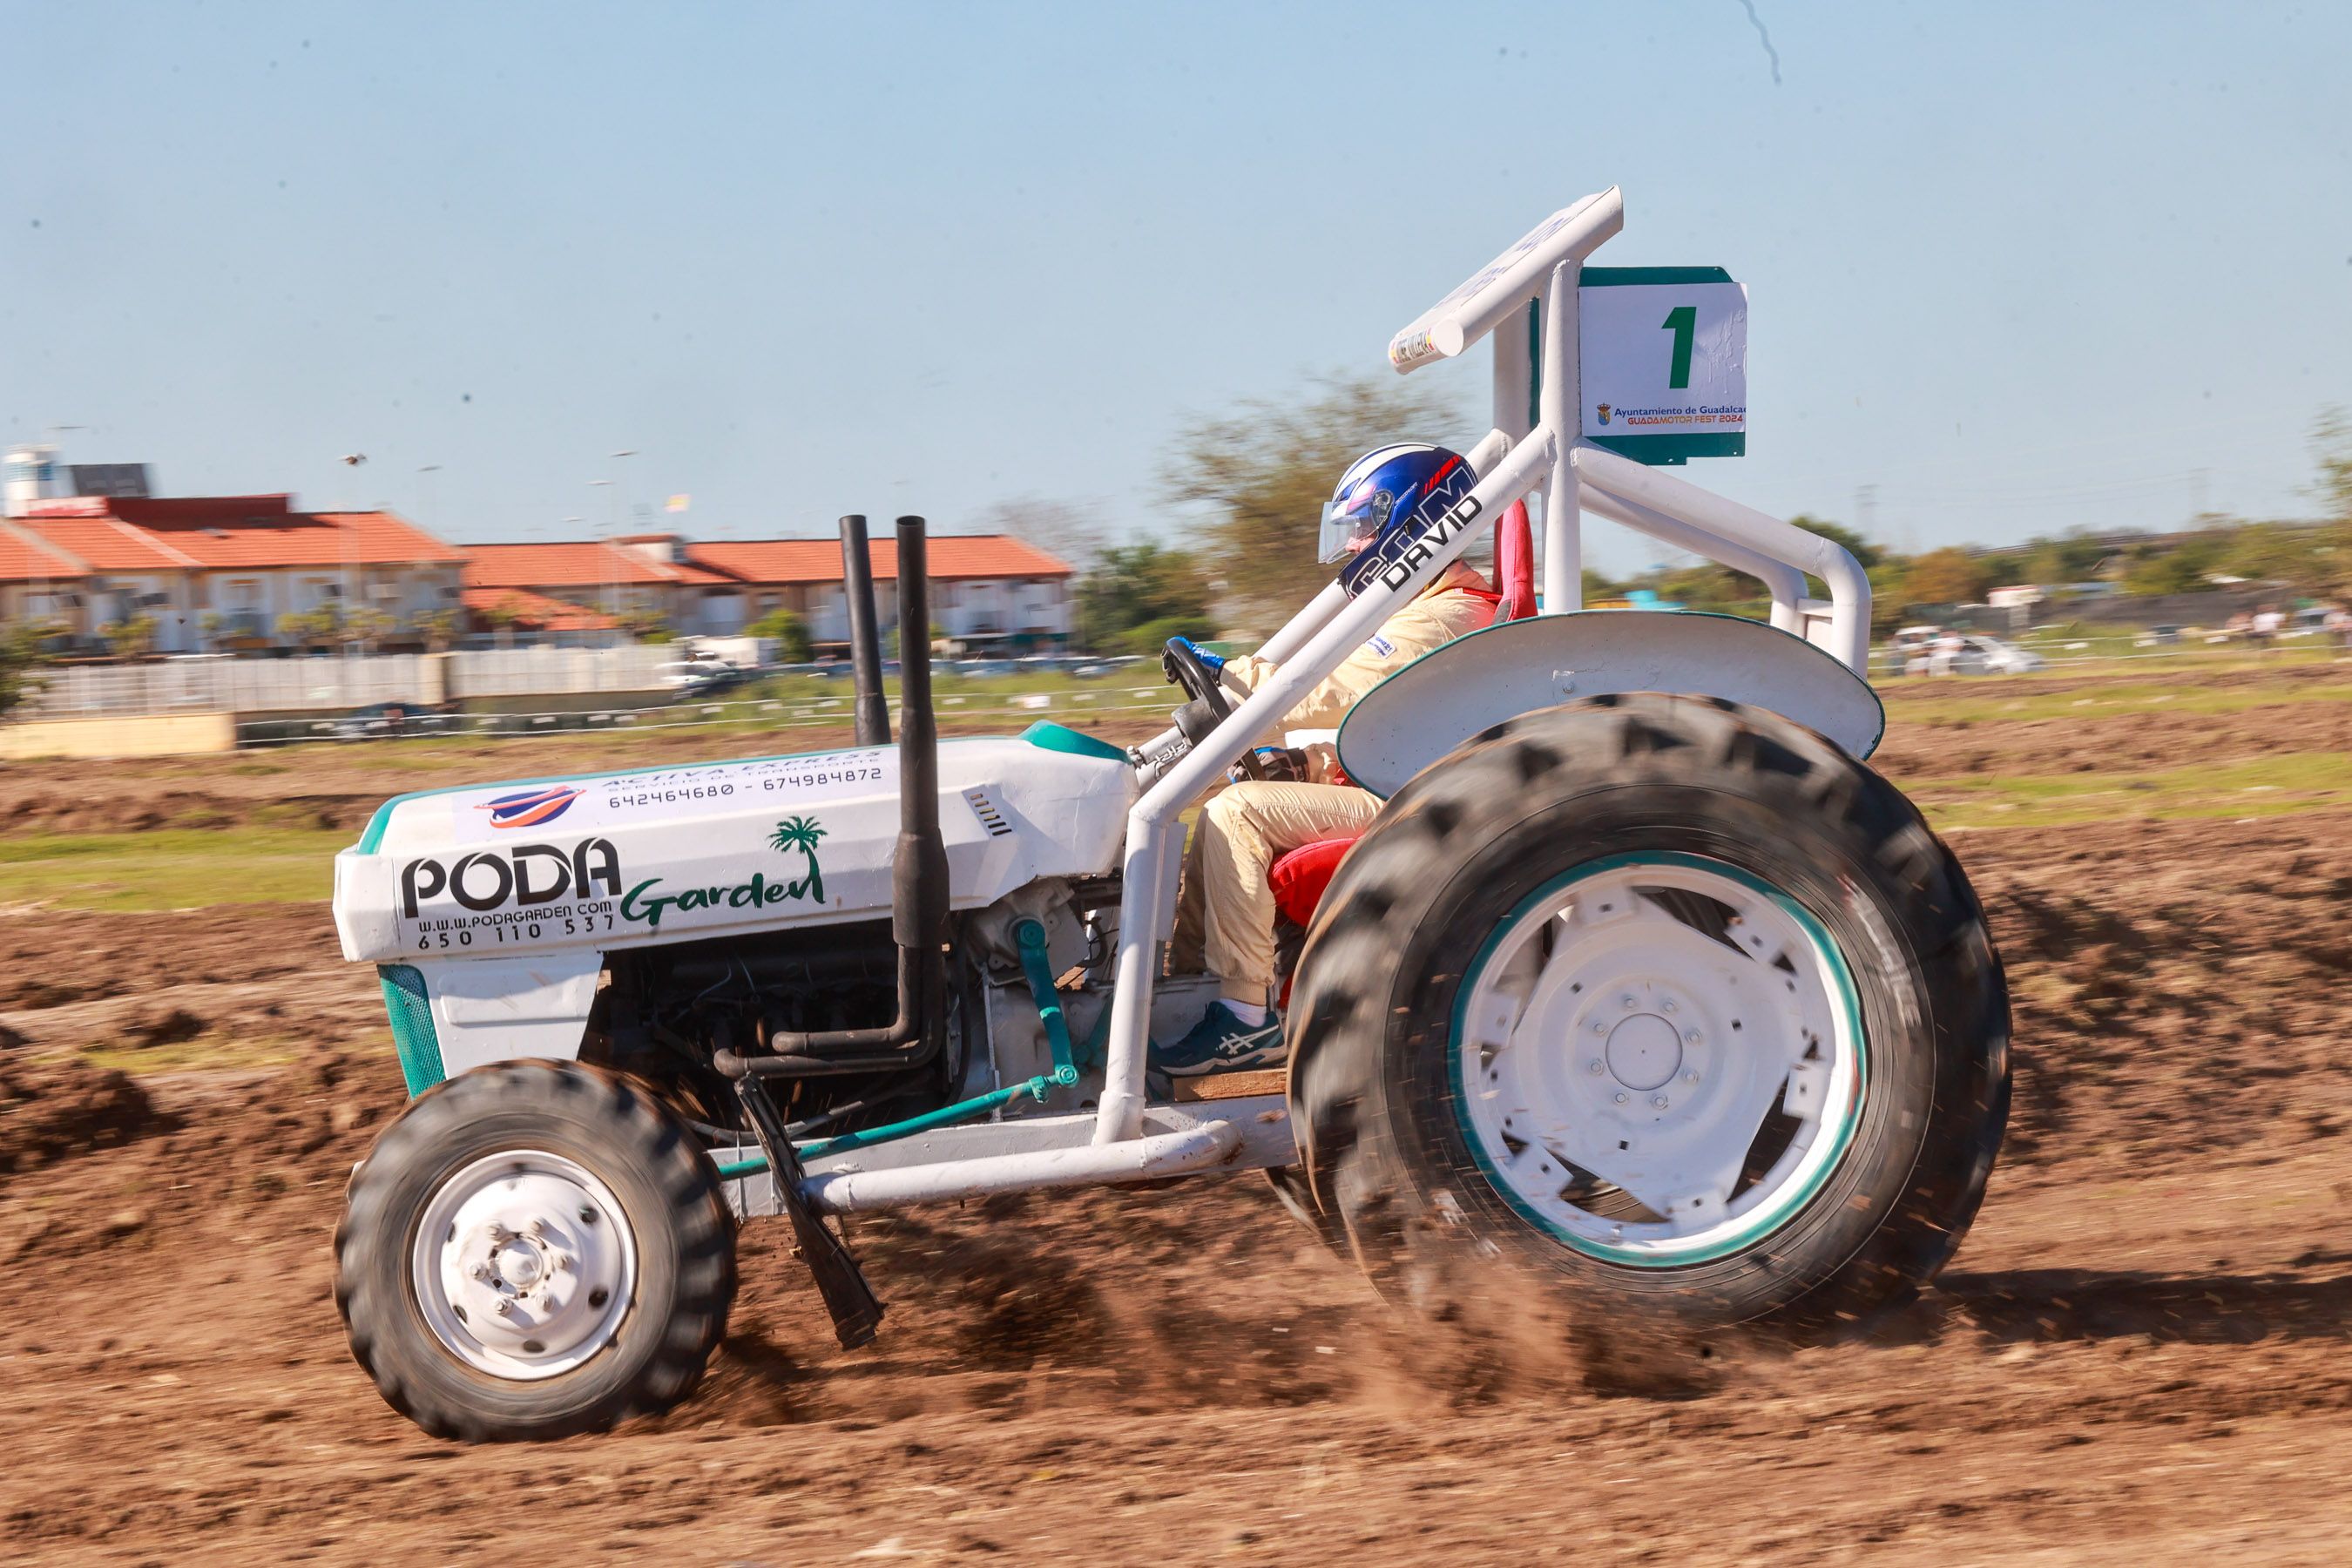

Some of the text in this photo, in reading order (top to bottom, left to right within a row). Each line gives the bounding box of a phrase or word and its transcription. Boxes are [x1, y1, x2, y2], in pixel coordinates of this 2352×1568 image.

[1661, 307, 1697, 389] 1
[1614, 407, 1682, 418] Ayuntamiento
[1685, 406, 1697, 415] de
[1627, 415, 1743, 425] GUADAMOTOR FEST 2024
[1381, 495, 1483, 593] DAVID
[741, 752, 882, 771] EXPRESS
[609, 784, 734, 808] 642464680
[763, 767, 882, 791] 674984872
[401, 837, 623, 919] PODA
[620, 866, 826, 927] Garden
[418, 915, 614, 950] 650 110 537
